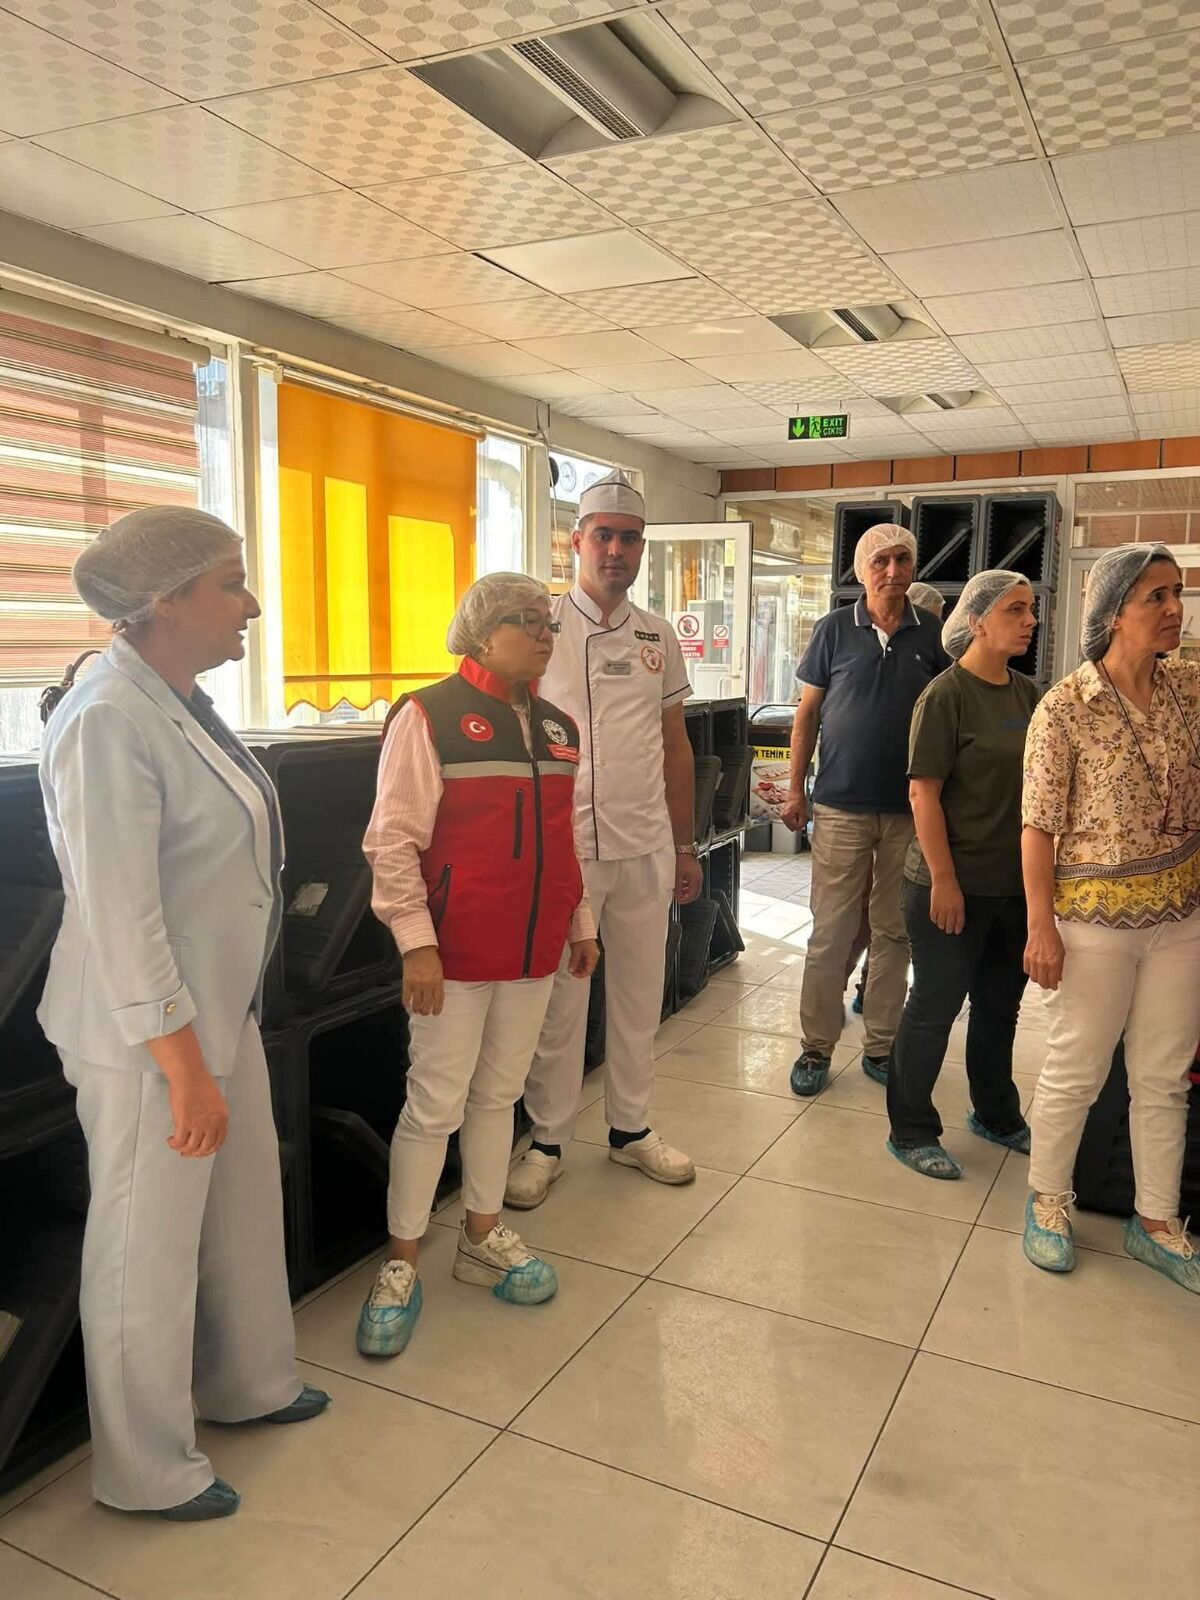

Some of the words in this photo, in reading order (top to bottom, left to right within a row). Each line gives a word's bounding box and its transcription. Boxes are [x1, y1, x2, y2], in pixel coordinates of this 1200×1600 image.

[823, 418, 844, 427] EXIT
[823, 427, 844, 436] ÇIKIŞ
[761, 749, 784, 759] TEMİN
